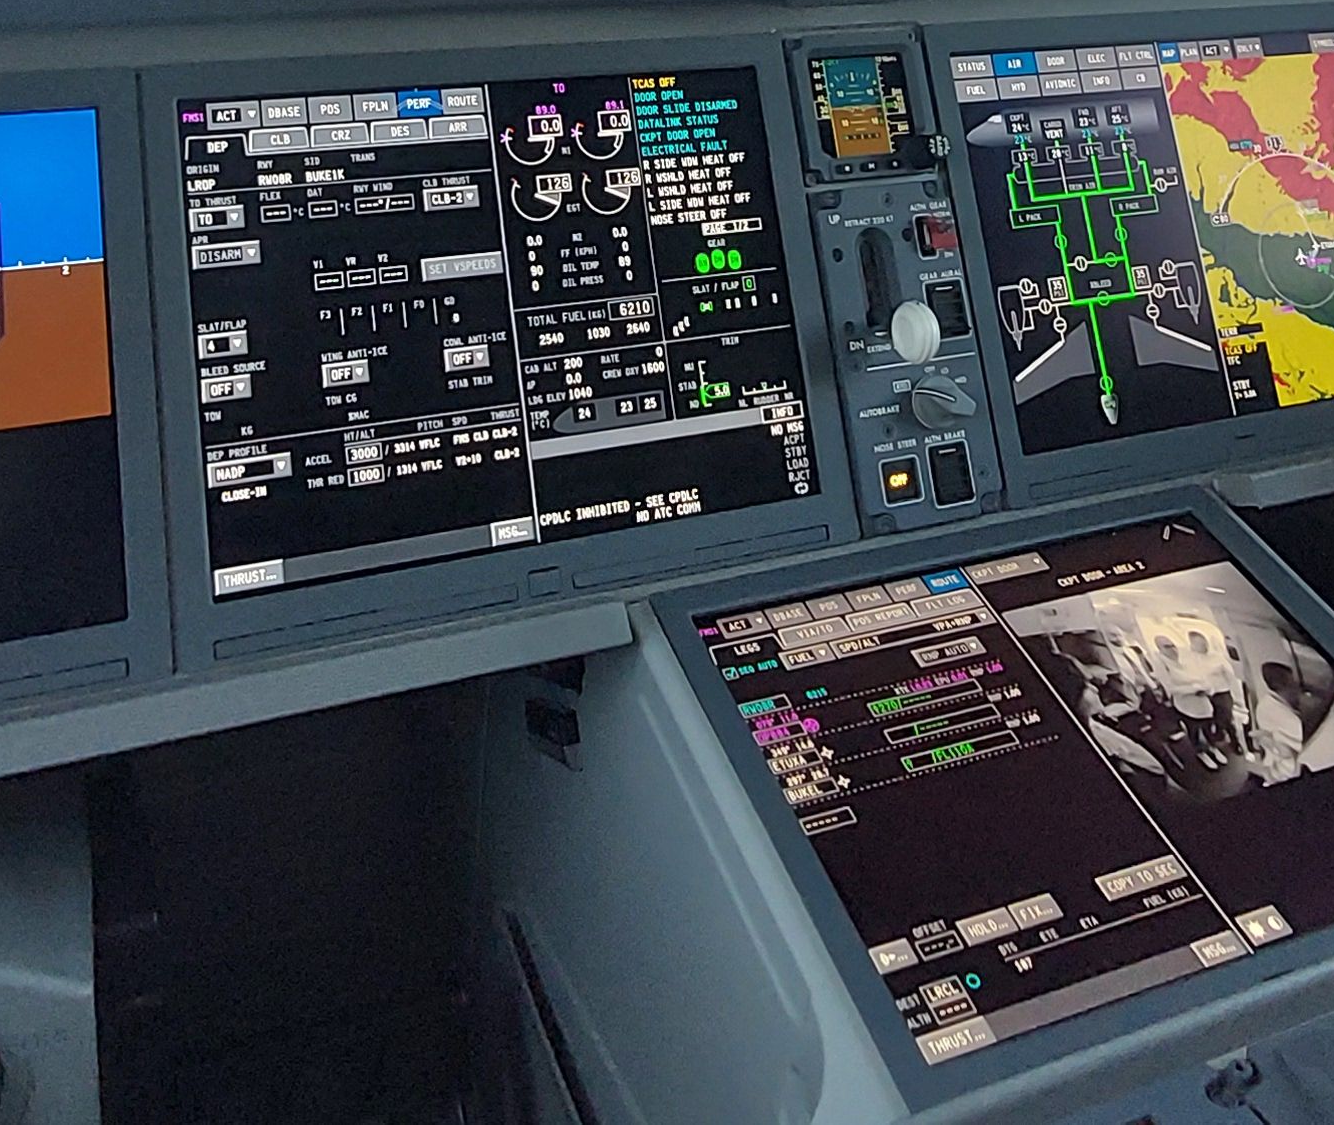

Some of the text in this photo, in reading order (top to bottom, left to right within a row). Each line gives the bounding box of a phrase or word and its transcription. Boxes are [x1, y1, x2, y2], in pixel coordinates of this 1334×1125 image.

[958, 61, 986, 72] STATUS
[1008, 59, 1022, 69] AIR
[1087, 53, 1106, 64] ELEC
[1119, 51, 1133, 62] FLT
[553, 83, 565, 93] TO
[632, 77, 675, 89] TCAS OFF
[634, 90, 683, 102] DOOR OPEN
[216, 110, 236, 121] ACT
[268, 106, 300, 118] DBASE
[320, 104, 340, 115] POS
[362, 101, 388, 112] FPLN
[407, 98, 431, 109] PERF
[448, 95, 477, 107] ROUTE
[636, 100, 738, 116] DOOR SLIDE DISARMED
[541, 115, 628, 133] 0.0 0.0
[638, 115, 719, 129] DATALINK STATUS
[207, 122, 467, 153] DEP CLB CRZ DES ARR
[640, 128, 716, 143] CKPT DOOR OPEN
[642, 140, 728, 156] ELECTRICAL FAULT
[547, 171, 639, 190] 126 126
[198, 193, 462, 225] TO CLB-2
[651, 209, 727, 225] NOSE STEER OFF
[828, 215, 840, 224] UP
[200, 249, 241, 262] DISARM
[197, 319, 247, 333] SLAT/FLAP
[539, 322, 650, 346] 2540 1030 2640
[850, 340, 864, 351] DN
[453, 353, 472, 366] OFF
[331, 367, 351, 380] OFF
[210, 383, 232, 396] OFF
[771, 421, 804, 436] NO MSG
[784, 434, 805, 445] ACPT
[785, 445, 806, 458] STBY
[787, 457, 809, 470] LOAD
[789, 470, 810, 482] RJCT
[931, 575, 960, 587] ROUTE
[728, 602, 838, 631] ACT DBASE POS
[852, 608, 909, 626] POS REPORT
[796, 625, 833, 639] VIA/TO
[734, 643, 760, 655] LEGS
[839, 636, 880, 654] SPD/ALT
[945, 645, 968, 657] AUTO
[788, 652, 815, 665] FUEL
[788, 785, 823, 801] BUKEL
[1106, 861, 1177, 893] COPY TO SEC
